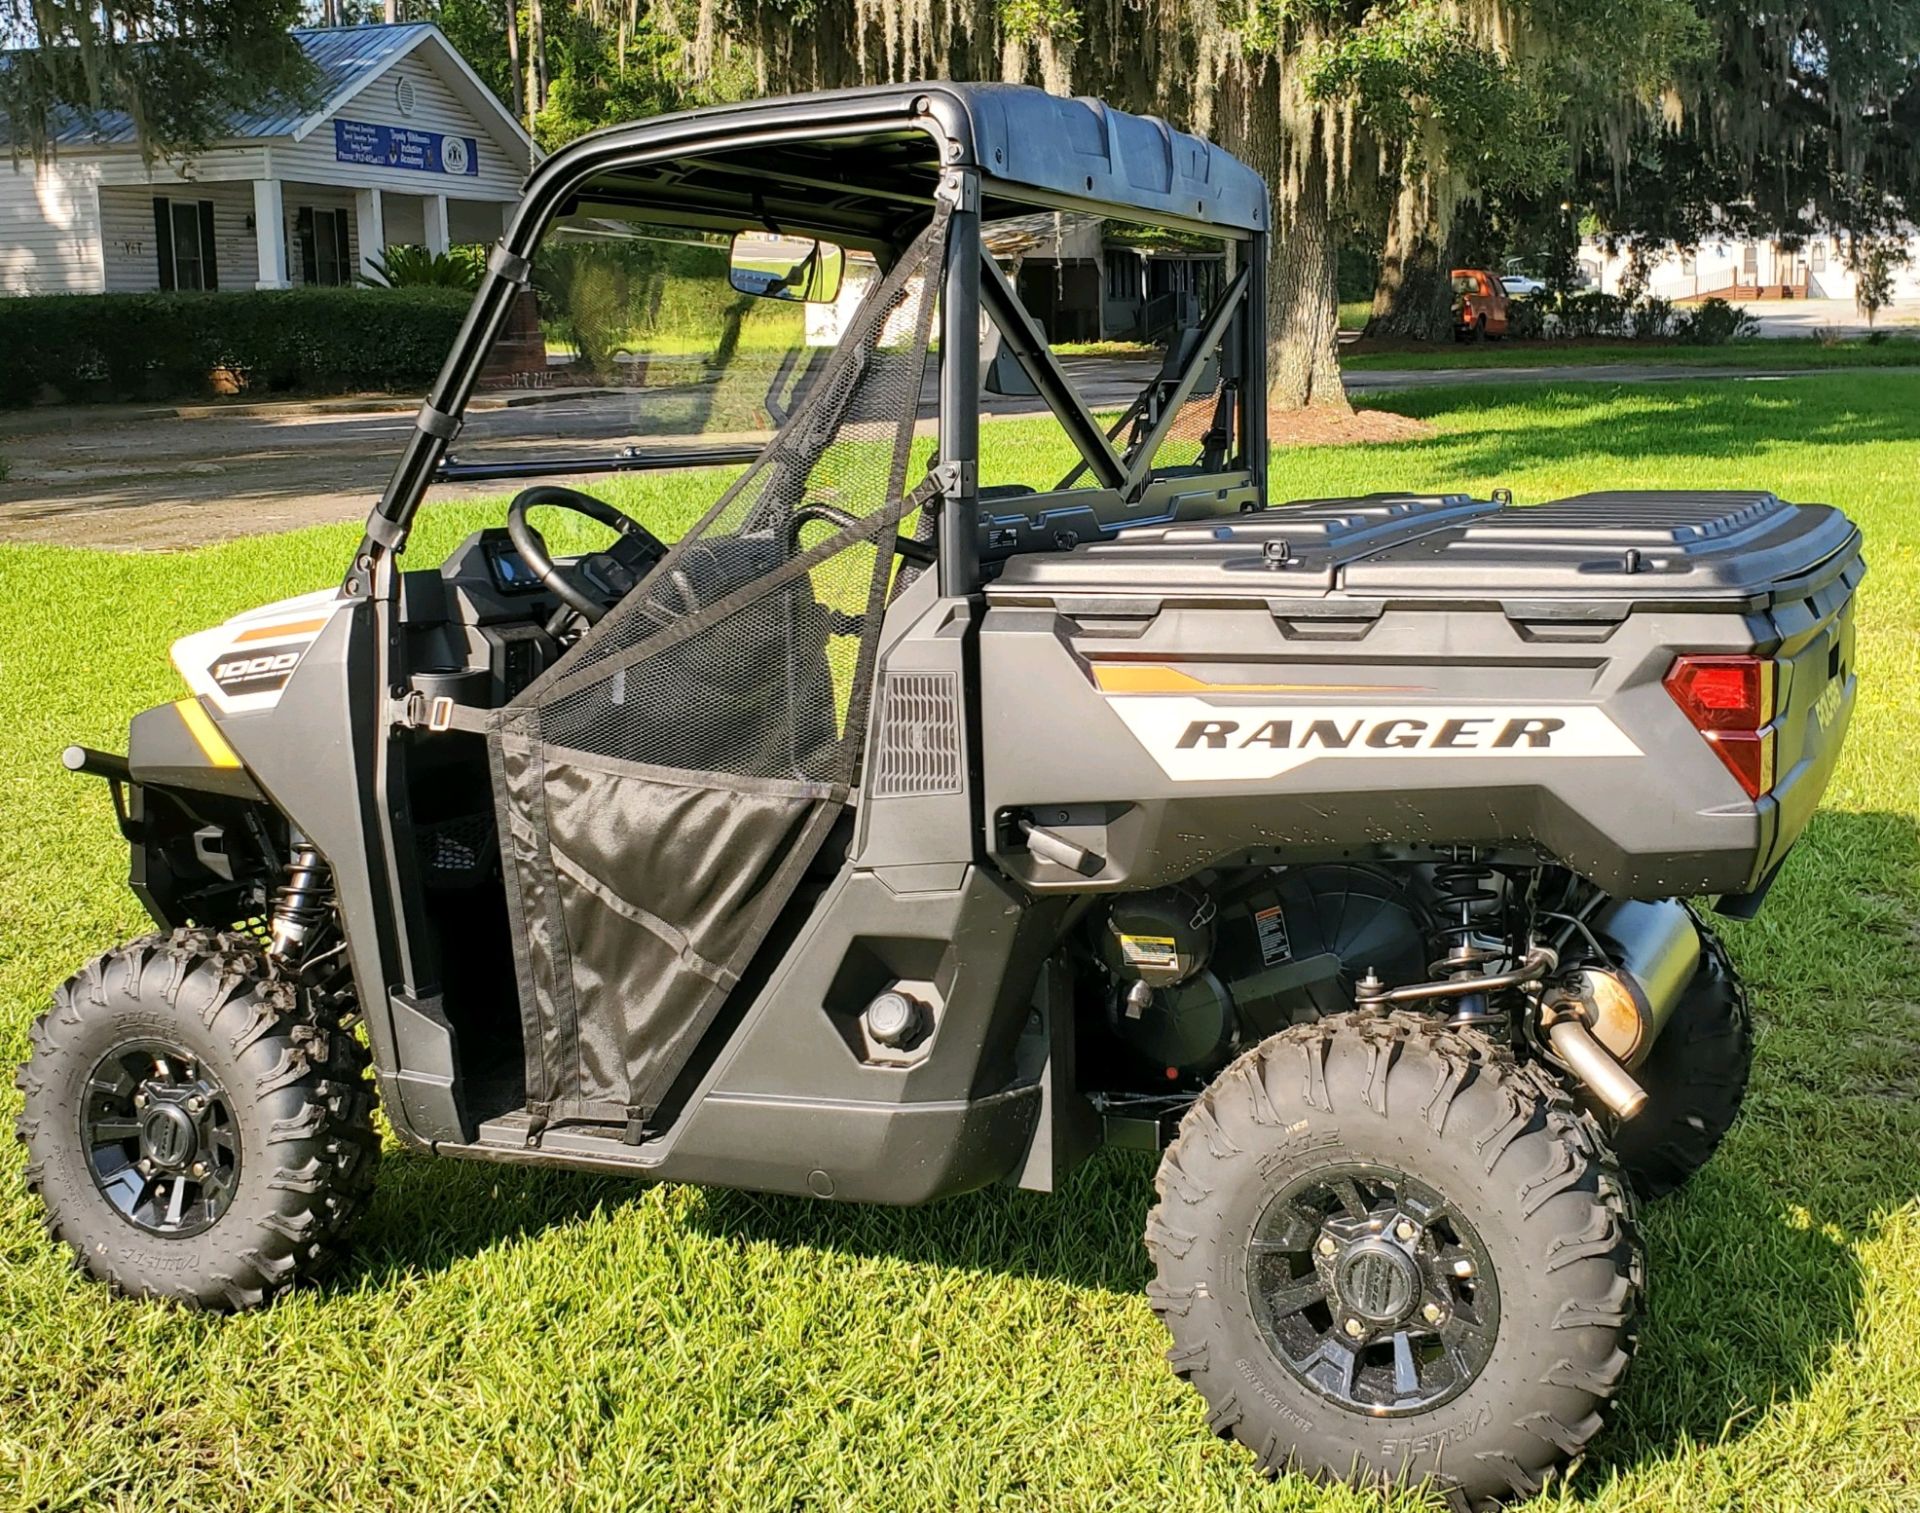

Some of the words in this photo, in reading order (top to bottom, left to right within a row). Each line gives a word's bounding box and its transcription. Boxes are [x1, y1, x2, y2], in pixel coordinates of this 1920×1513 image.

[215, 652, 300, 679] 1000
[1174, 717, 1566, 749] RANGER
[1380, 1400, 1494, 1456] CARLISLE
